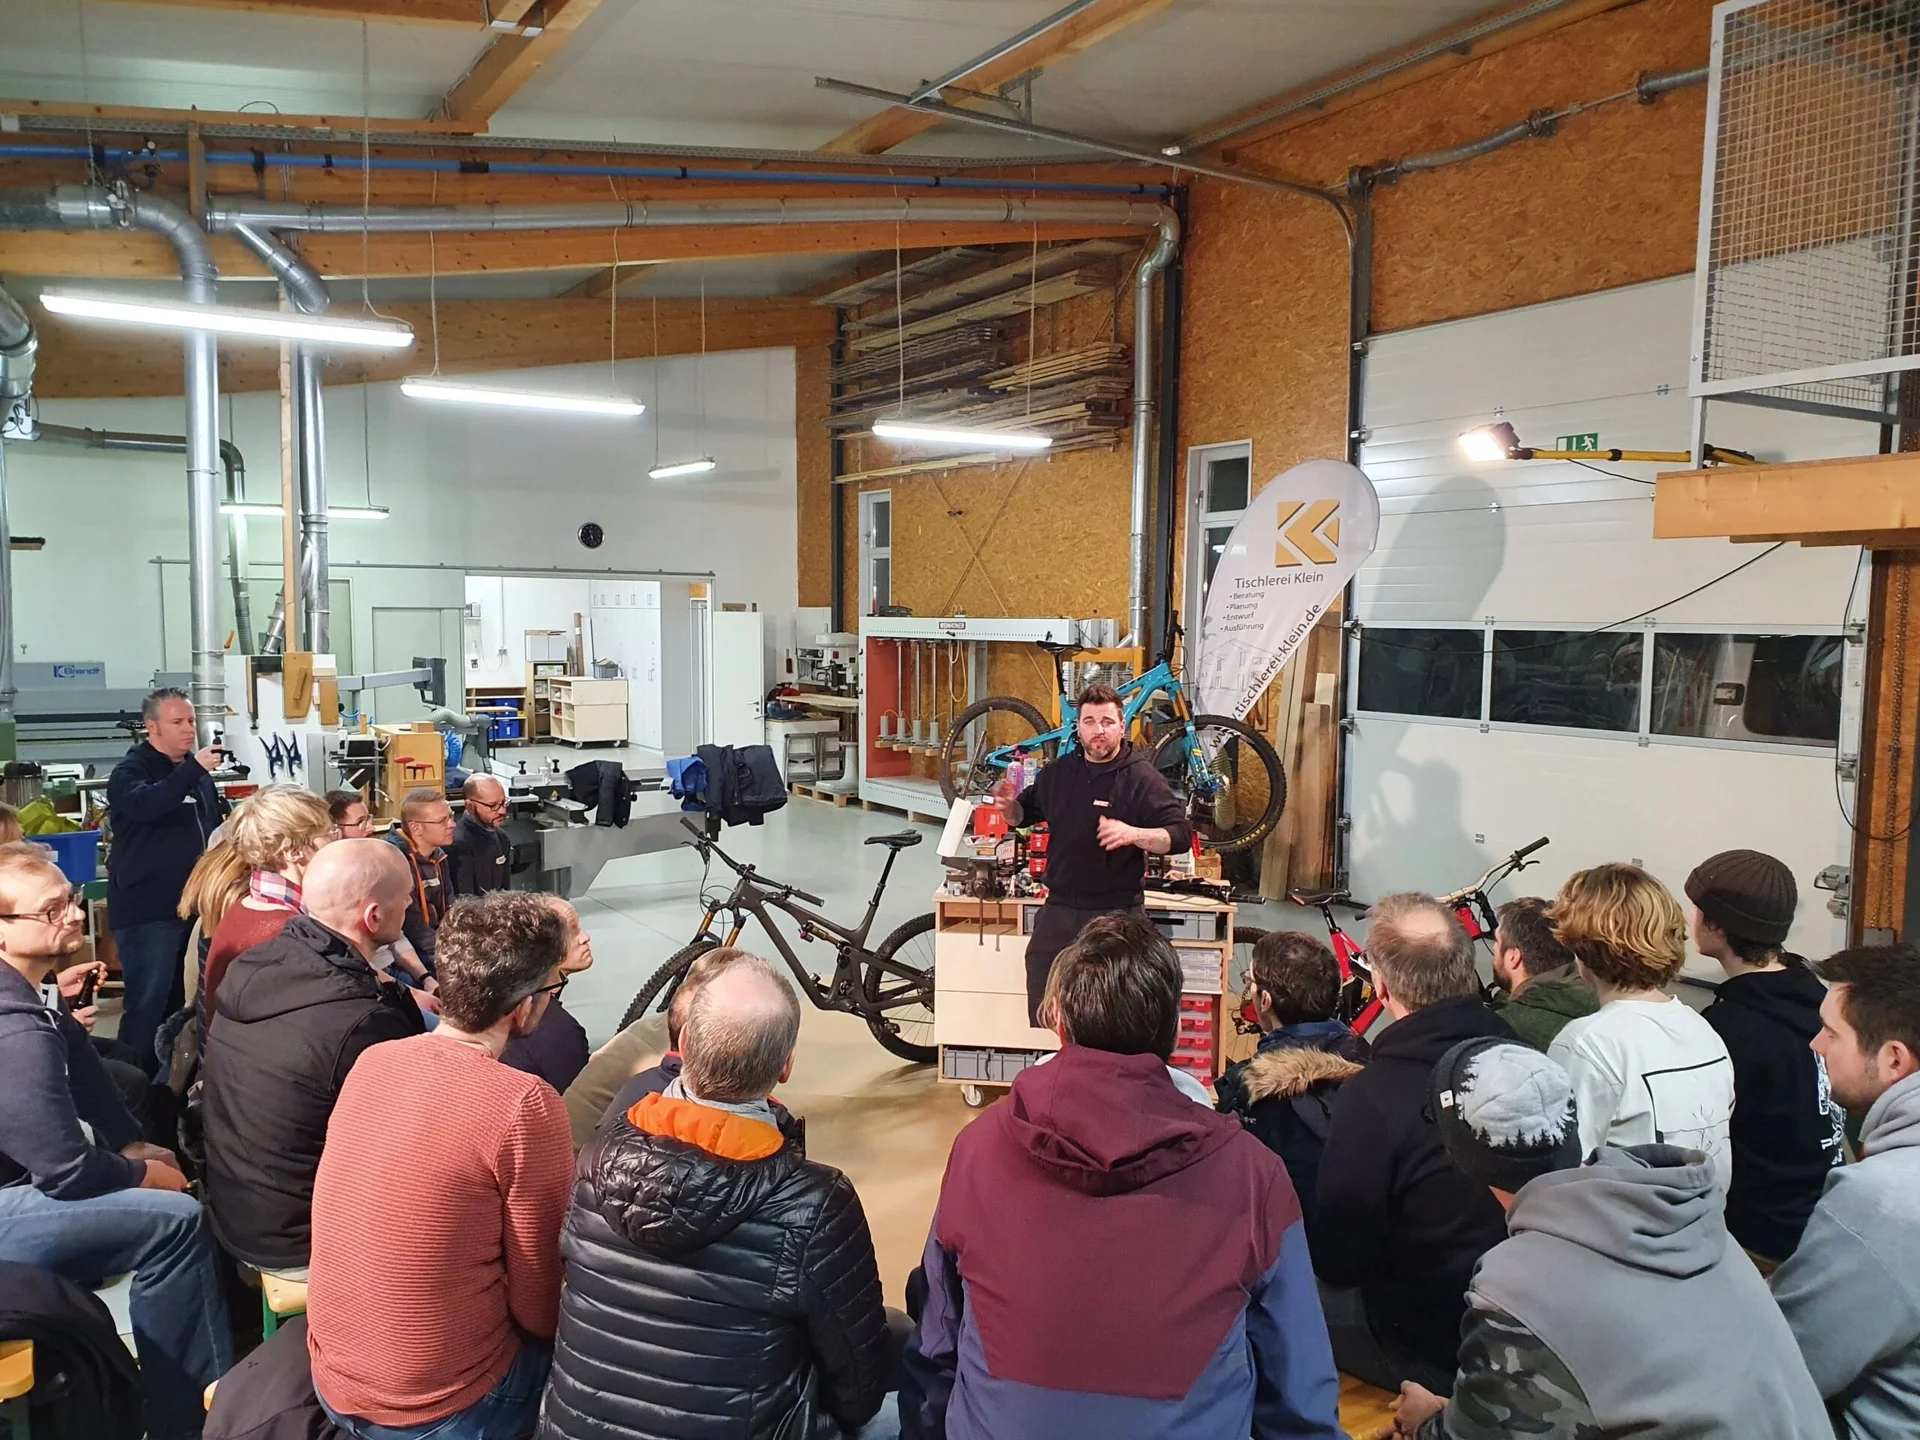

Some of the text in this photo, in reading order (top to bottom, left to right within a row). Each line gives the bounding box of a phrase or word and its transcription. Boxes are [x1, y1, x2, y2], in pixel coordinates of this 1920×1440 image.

[1234, 571, 1324, 589] Tischlerei Klein
[1233, 591, 1265, 600] Beratung
[1229, 602, 1259, 610] Planung
[1226, 611, 1255, 621] Entwurf
[1223, 623, 1265, 632] Ausführung
